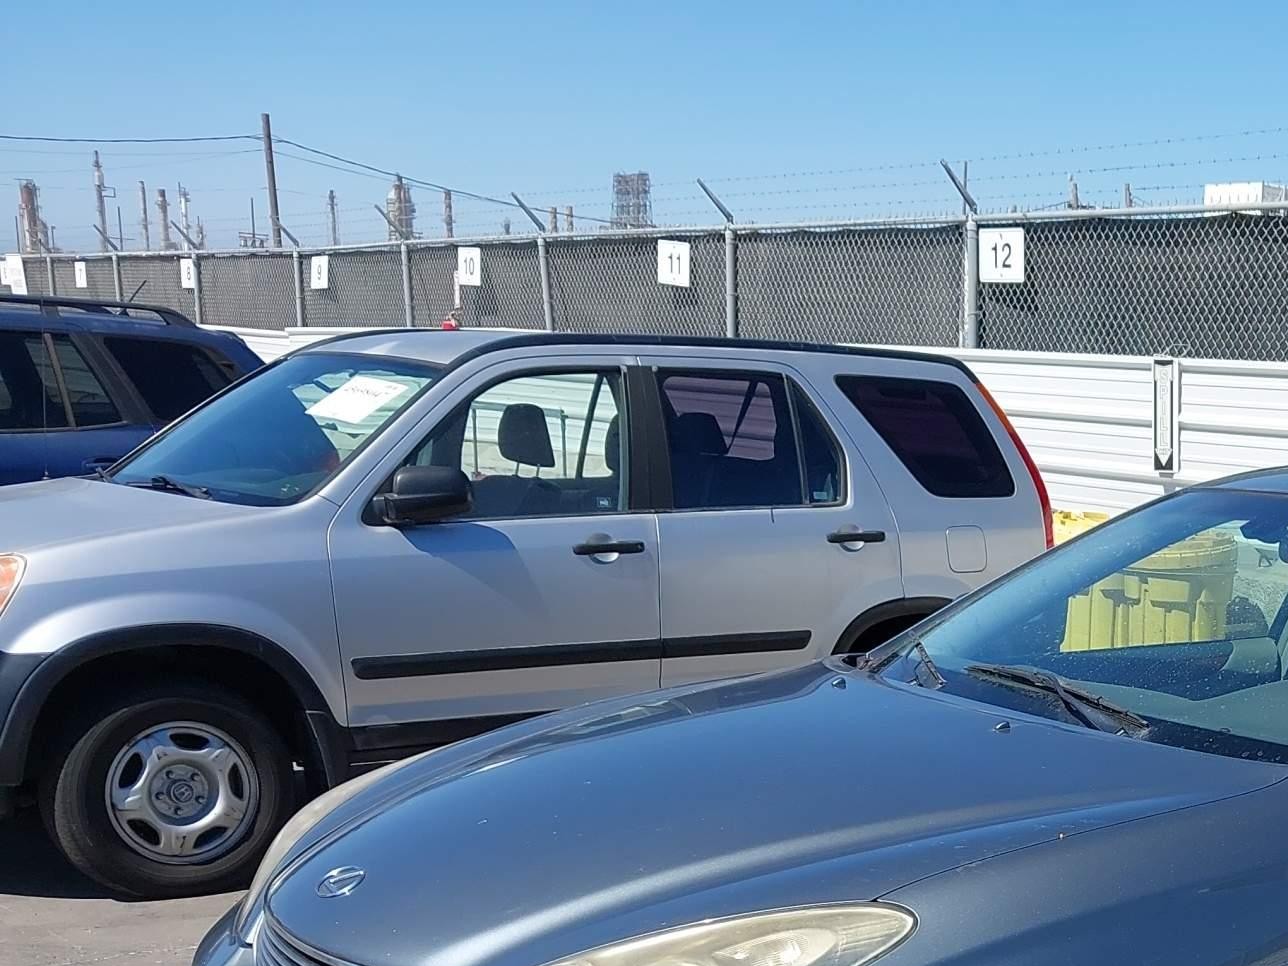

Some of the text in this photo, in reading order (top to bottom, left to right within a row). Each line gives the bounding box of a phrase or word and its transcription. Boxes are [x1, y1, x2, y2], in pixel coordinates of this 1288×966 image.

[463, 256, 475, 275] 10
[667, 252, 681, 275] 11
[991, 243, 1012, 268] 12
[317, 264, 322, 280] 9
[1159, 368, 1169, 447] SPILL
